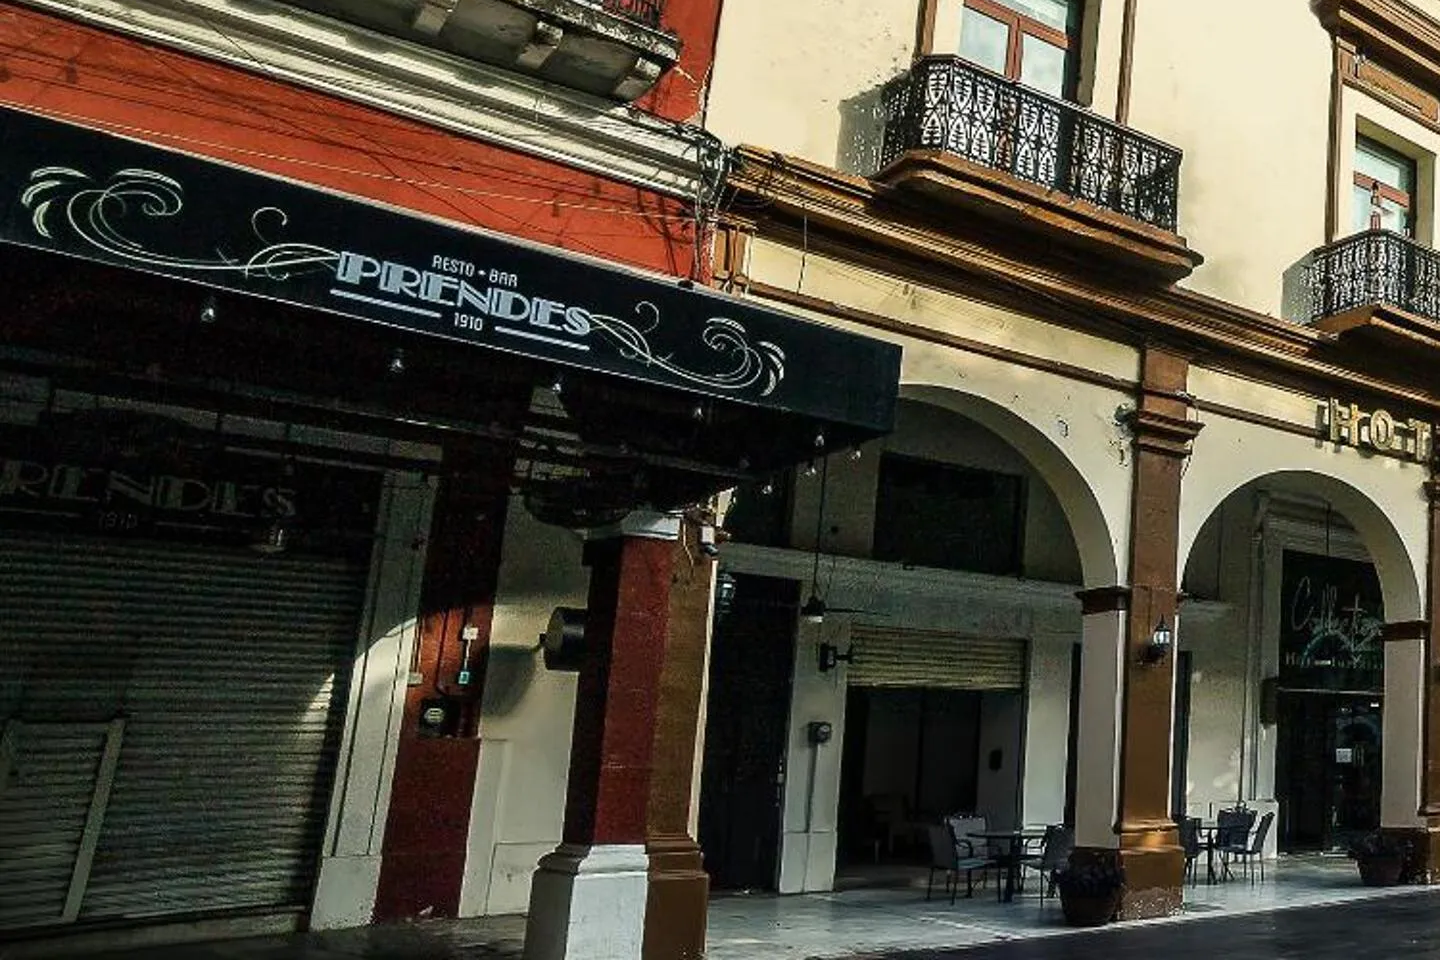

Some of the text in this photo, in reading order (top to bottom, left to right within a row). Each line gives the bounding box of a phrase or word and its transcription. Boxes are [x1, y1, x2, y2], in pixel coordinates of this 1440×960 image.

[432, 254, 518, 288] RESTO BAR
[335, 251, 592, 336] PRENDES
[453, 311, 484, 332] 1910
